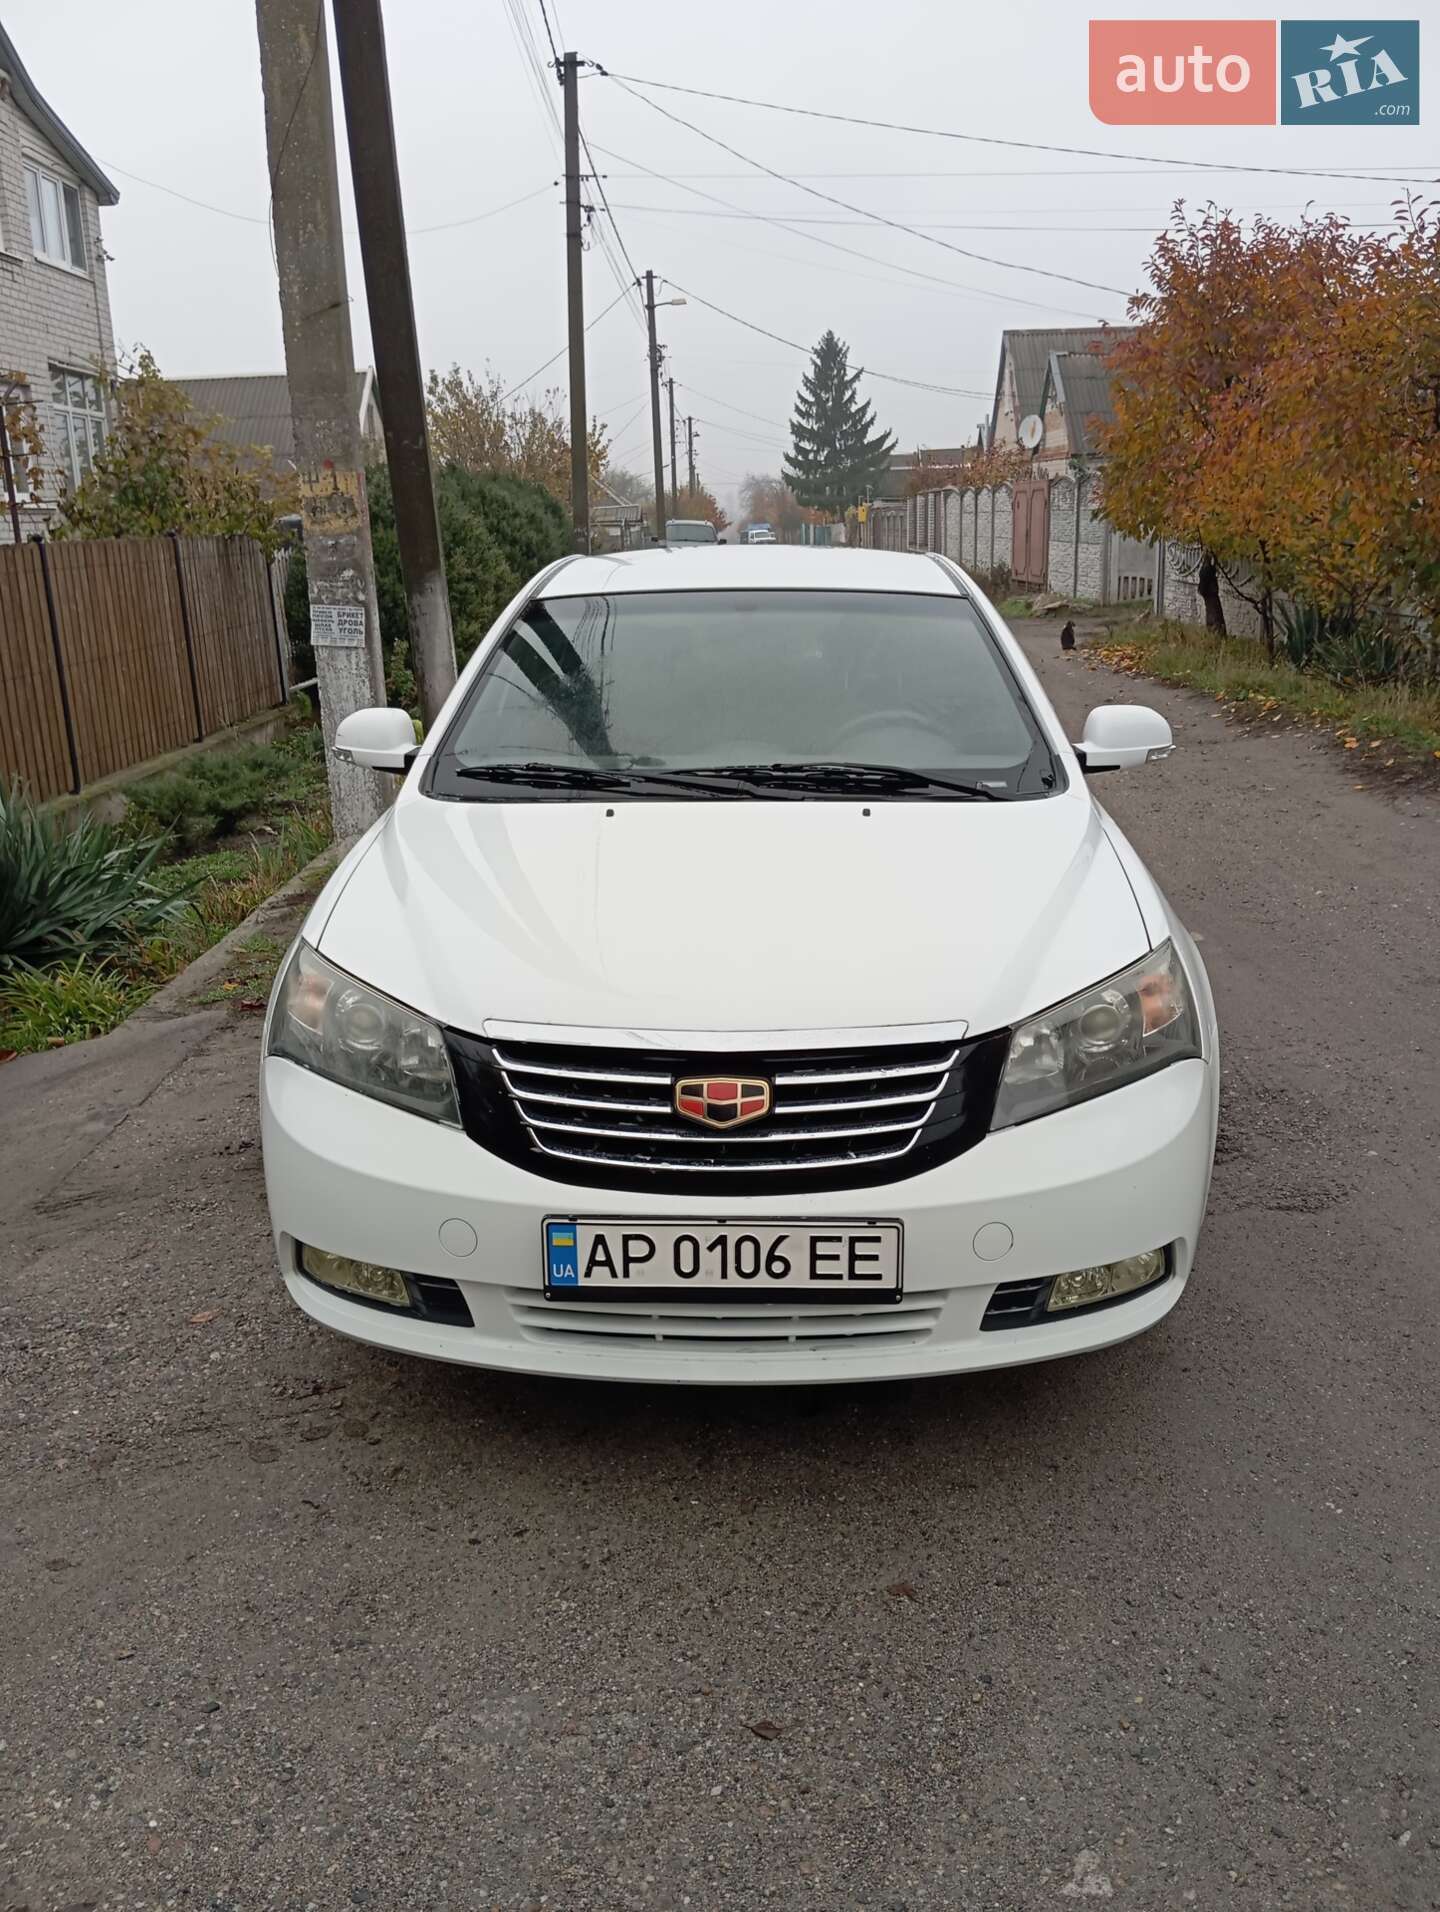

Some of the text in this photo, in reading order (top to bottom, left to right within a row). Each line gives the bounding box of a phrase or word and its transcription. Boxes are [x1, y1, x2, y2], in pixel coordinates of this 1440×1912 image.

[336, 611, 363, 619] БРИКЕТ
[338, 627, 363, 635] УГОЛЬ
[584, 1234, 883, 1281] AP 0106 EE
[552, 1263, 576, 1278] UA
